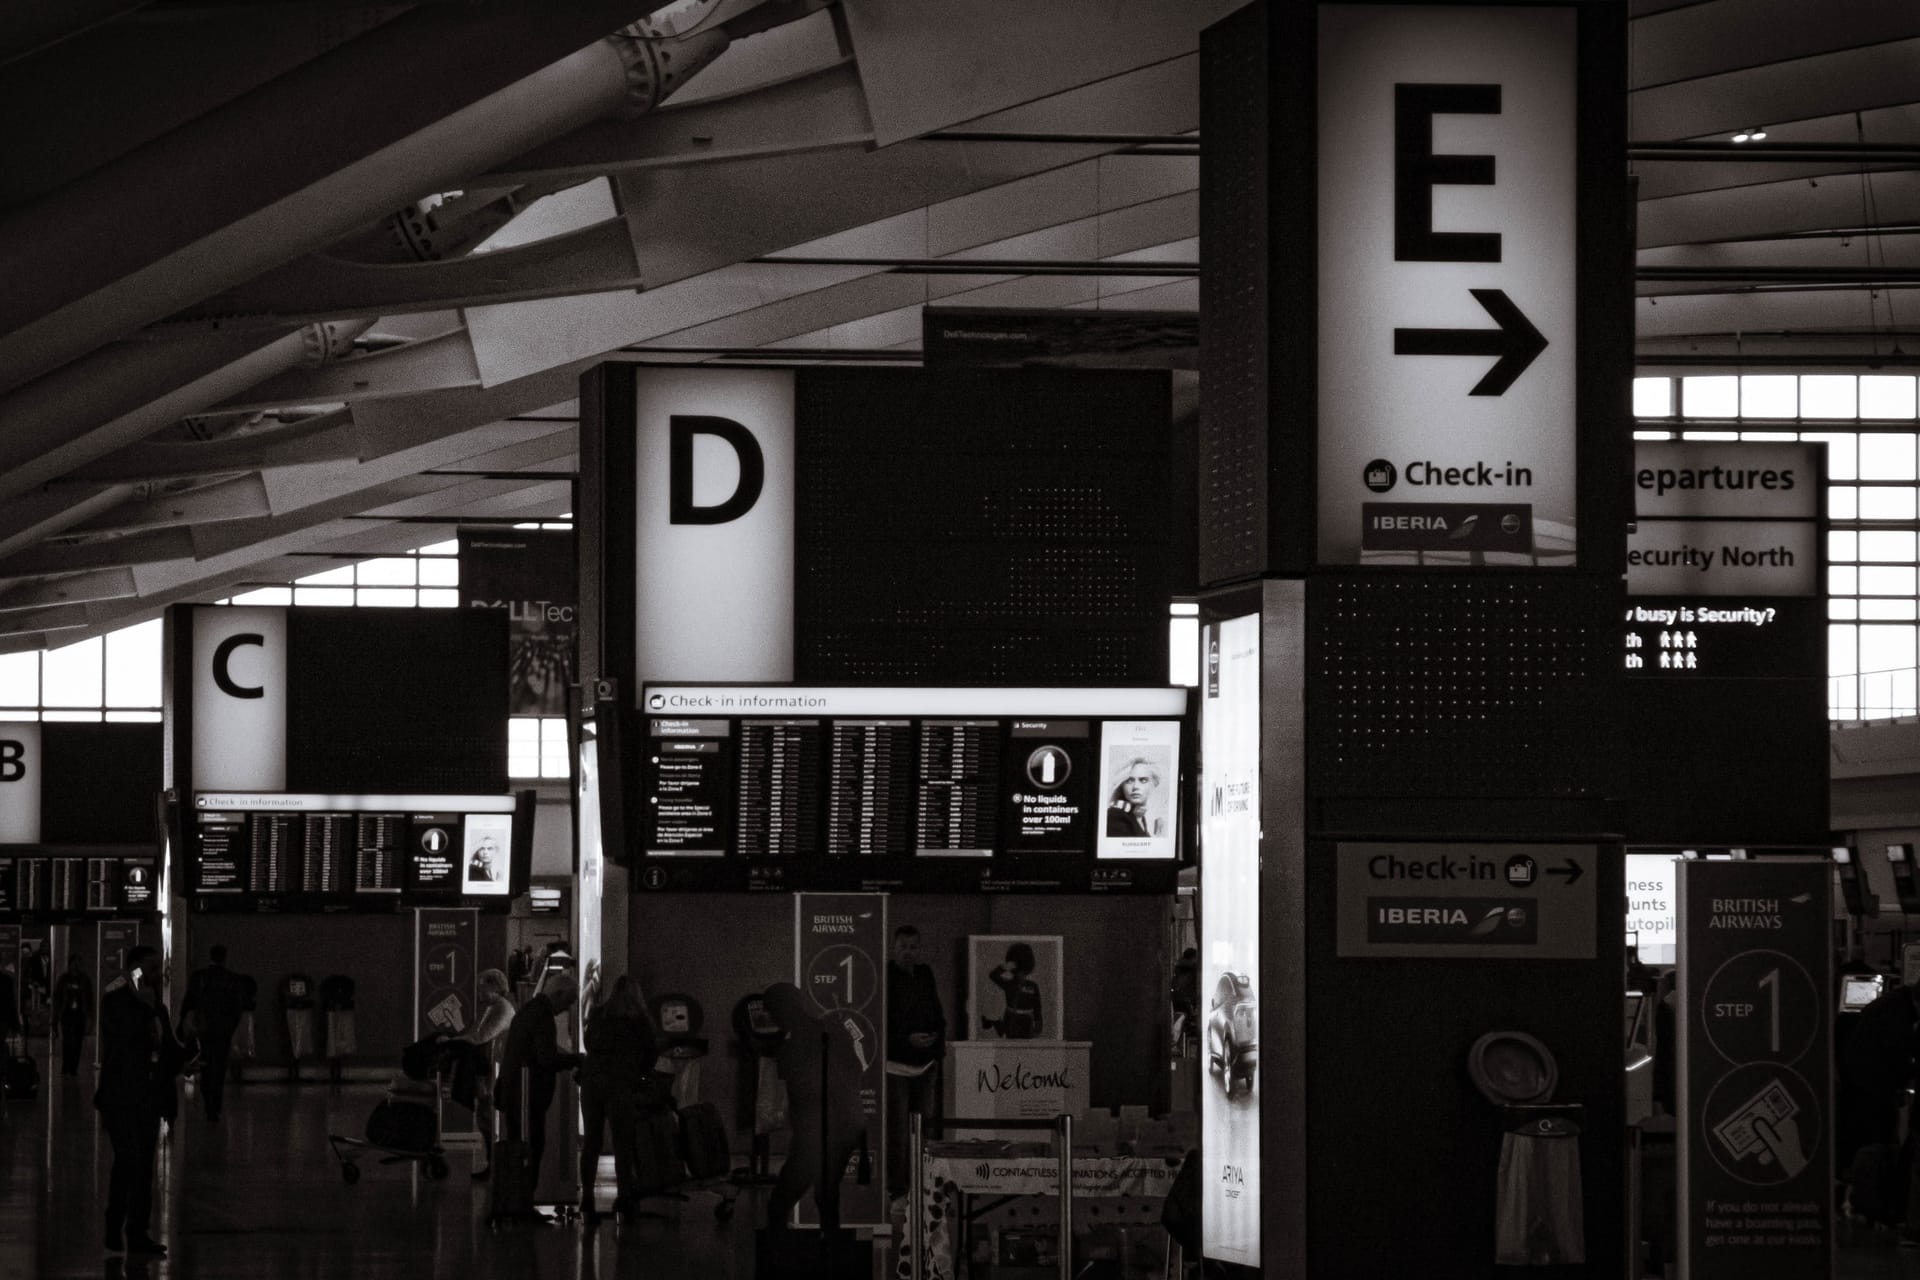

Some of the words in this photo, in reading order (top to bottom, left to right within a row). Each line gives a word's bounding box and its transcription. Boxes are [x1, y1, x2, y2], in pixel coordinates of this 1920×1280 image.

[1395, 84, 1502, 262] E
[670, 415, 764, 525] D
[1405, 461, 1532, 486] Check-in
[1637, 467, 1794, 496] epartures
[1373, 516, 1448, 530] IBERIA
[1628, 545, 1714, 571] ecurity
[1722, 546, 1794, 566] North
[1635, 606, 1677, 626] busy
[1680, 606, 1695, 623] is
[1697, 606, 1776, 626] Security?
[1626, 632, 1643, 648] th
[213, 633, 264, 699] C
[1626, 653, 1643, 669] th
[670, 695, 734, 707] Check-in
[739, 695, 827, 707] information
[1021, 722, 1047, 730] Security
[0, 740, 26, 782] B
[1023, 795, 1037, 803] No
[1038, 794, 1067, 805] liquids
[1023, 805, 1032, 813] in
[1033, 805, 1079, 814] containers
[1022, 816, 1042, 824] over
[1044, 815, 1071, 824] 100ml
[1369, 855, 1496, 880] Check-in
[1628, 881, 1664, 892] ness
[1631, 899, 1667, 911] unts
[1712, 899, 1779, 913] BRITISH
[813, 915, 853, 924] BRITISH
[1379, 908, 1468, 924] IBERIA
[1709, 914, 1783, 929] AIRWAYS
[811, 924, 855, 934] AIRWAYS
[1627, 917, 1675, 934] utopil
[814, 975, 837, 984] STEP
[839, 954, 854, 1004] 1
[1715, 1003, 1754, 1017] STEP
[1758, 967, 1781, 1053] 1
[977, 1064, 1070, 1094] Welcome
[993, 1166, 1058, 1179] CONTACTLESS
[1072, 1168, 1118, 1180] NATIONS
[1706, 1200, 1716, 1212] If
[1718, 1203, 1740, 1214] you
[1742, 1200, 1759, 1212] do
[1760, 1202, 1780, 1212] not
[1705, 1217, 1733, 1228] have
[1727, 1235, 1751, 1245] one
